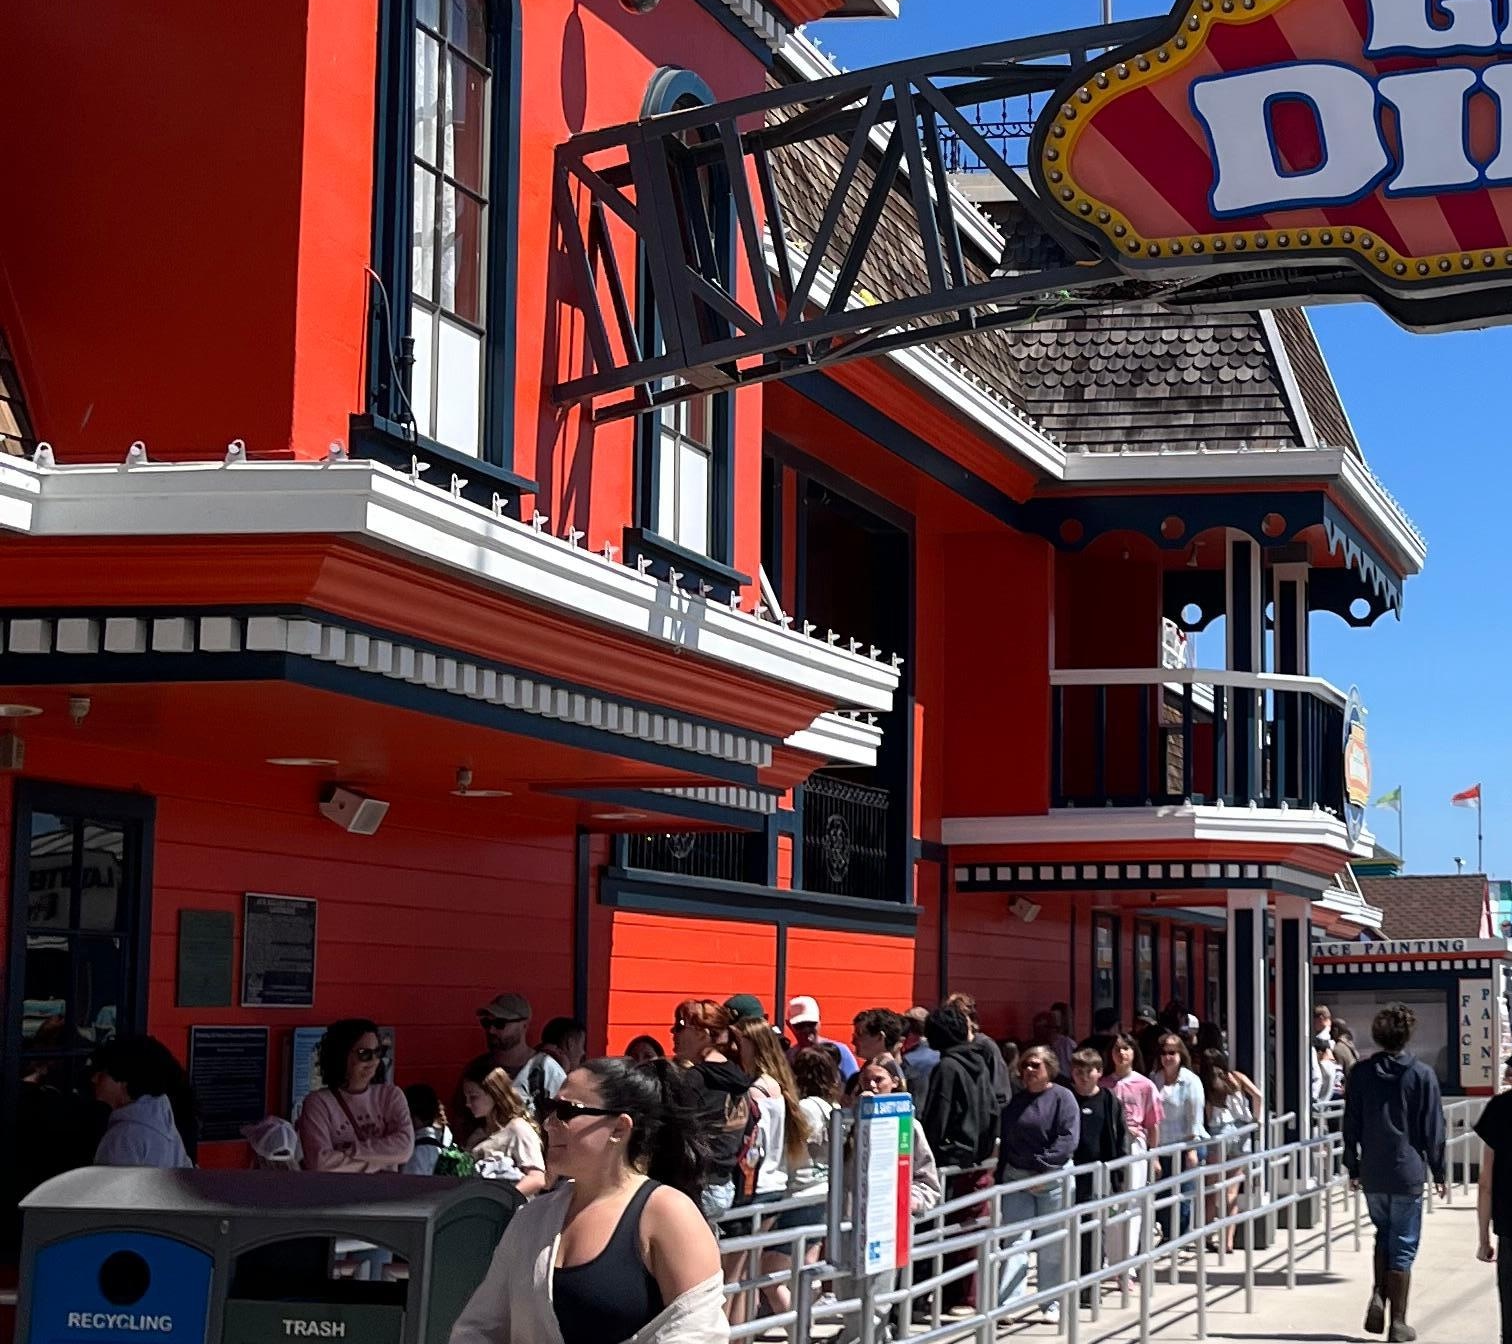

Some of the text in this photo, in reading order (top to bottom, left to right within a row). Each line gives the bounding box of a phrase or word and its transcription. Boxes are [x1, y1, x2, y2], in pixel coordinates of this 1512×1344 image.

[1314, 940, 1465, 956] ACE PAINTING
[1462, 995, 1472, 1066] FACE
[1481, 988, 1491, 1078] PAINT
[68, 1312, 173, 1332] RECYCLING
[282, 1319, 346, 1337] TRASH
